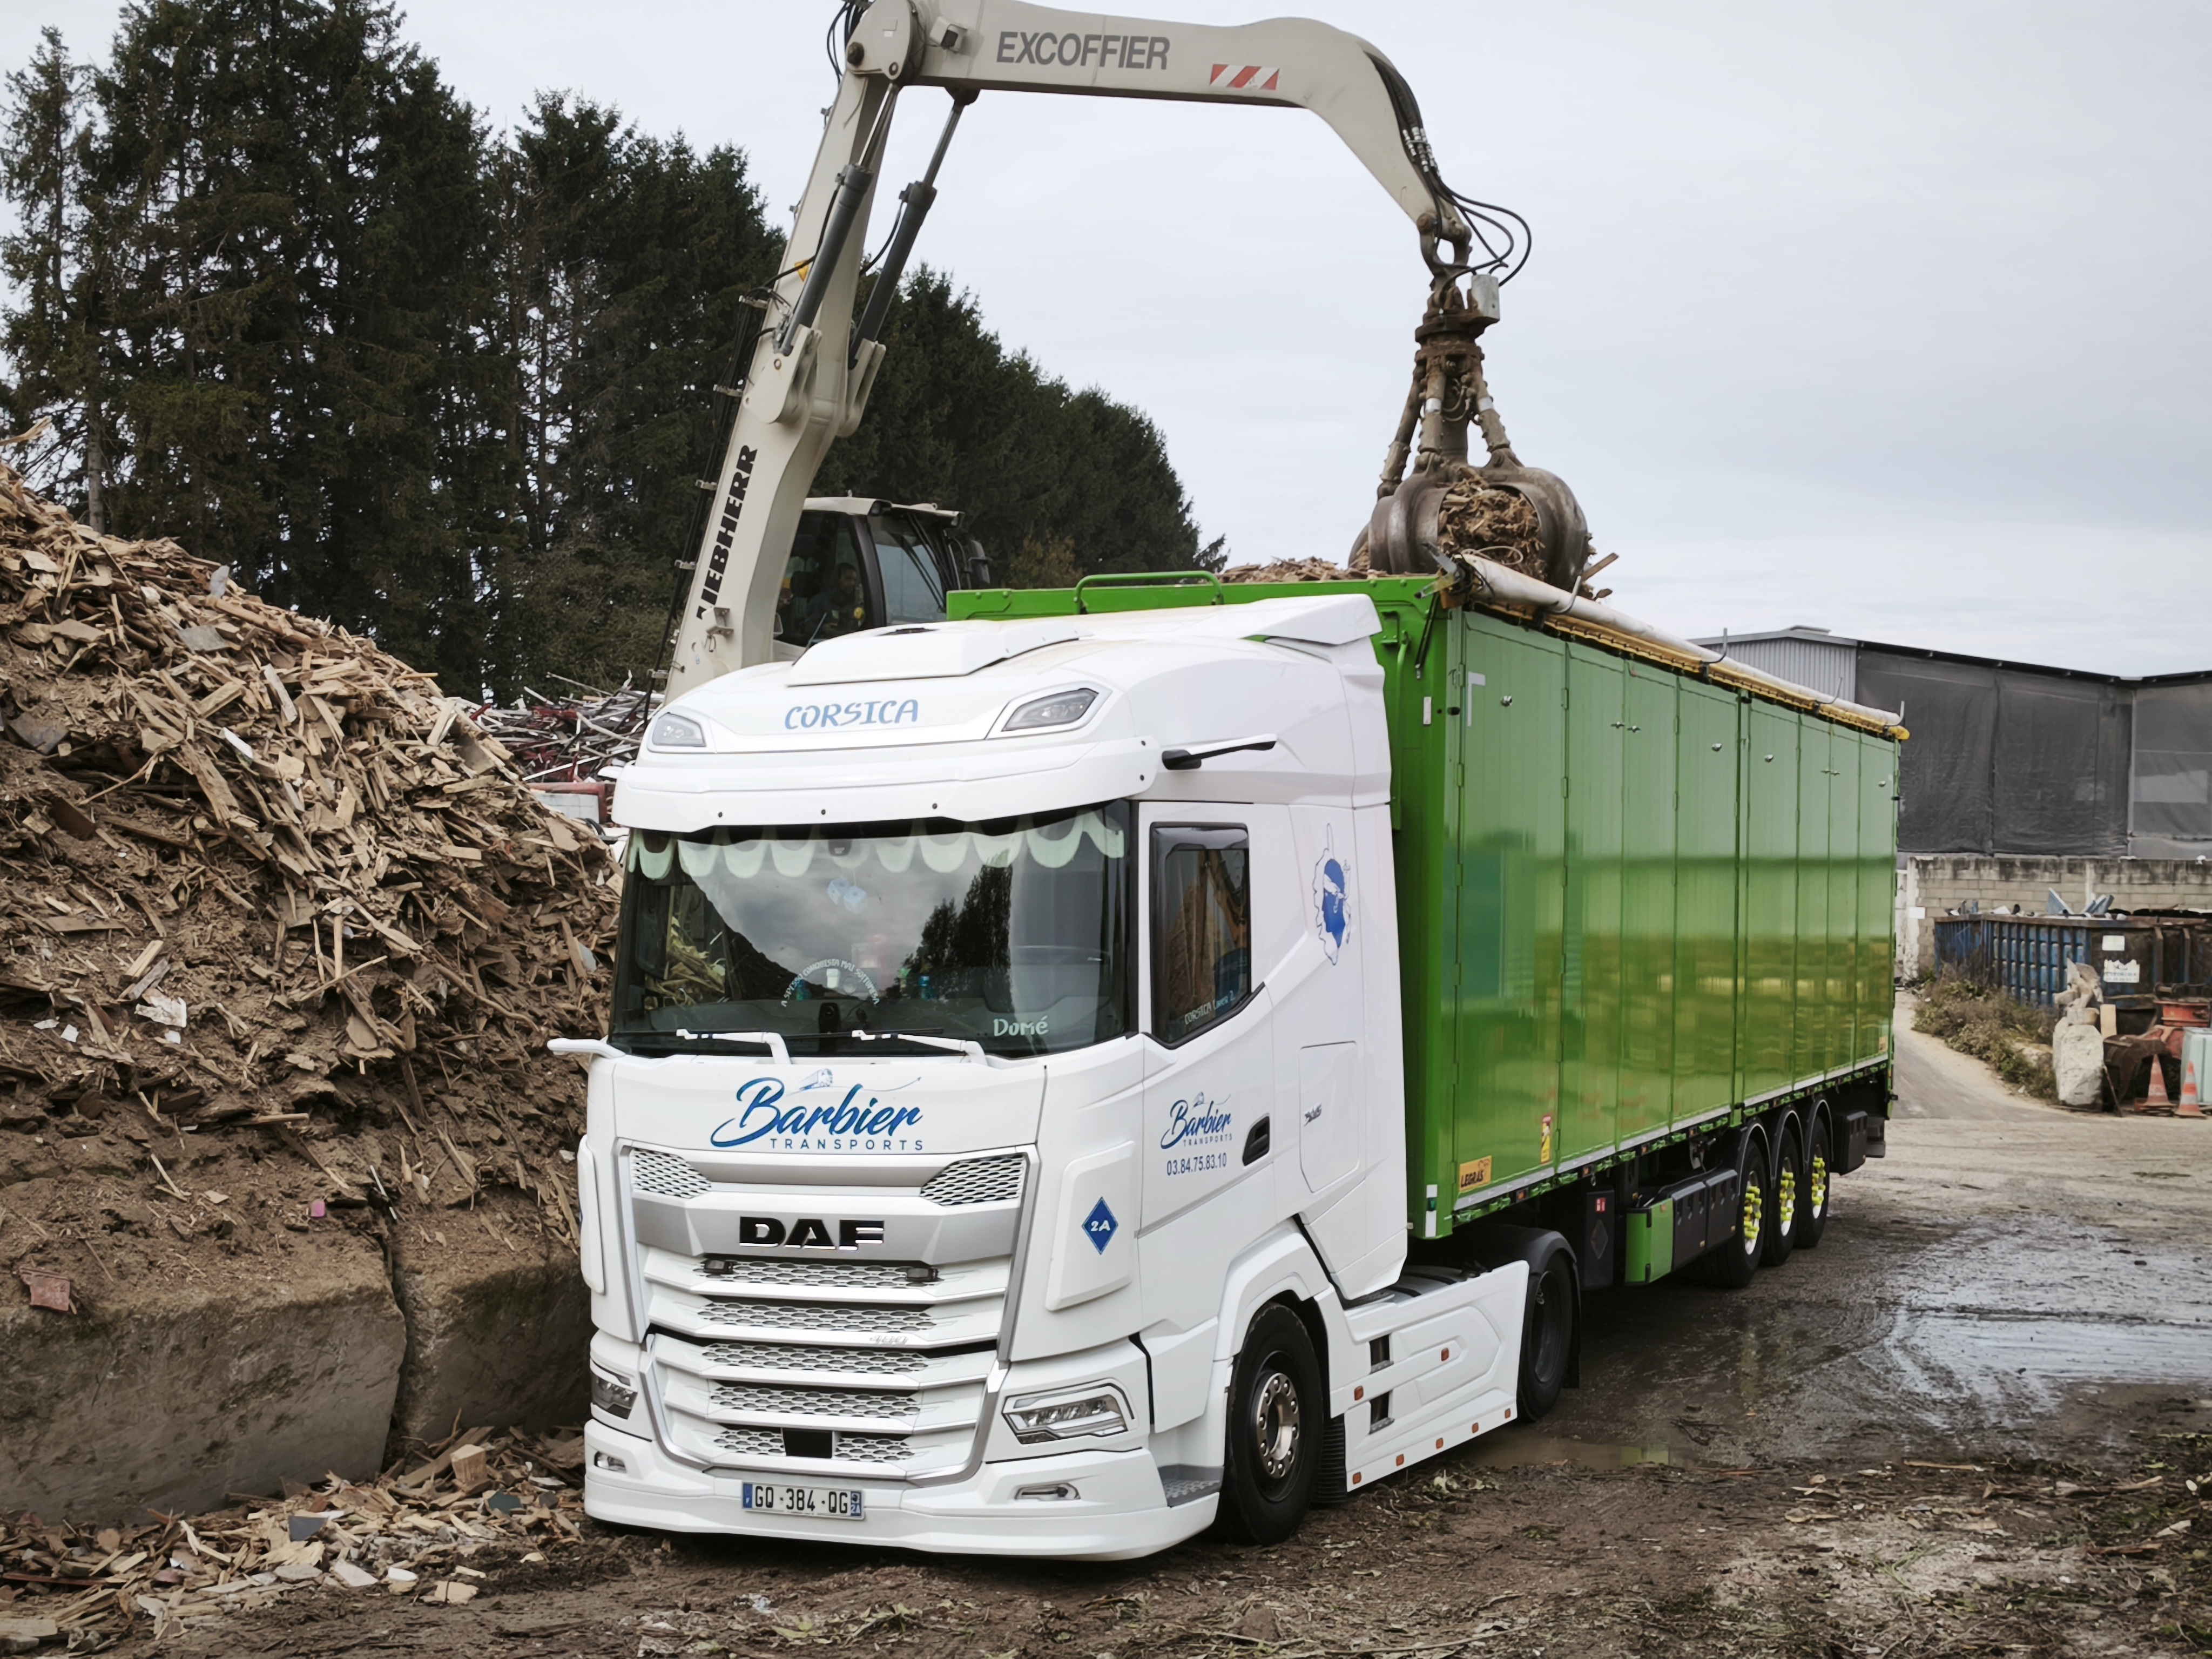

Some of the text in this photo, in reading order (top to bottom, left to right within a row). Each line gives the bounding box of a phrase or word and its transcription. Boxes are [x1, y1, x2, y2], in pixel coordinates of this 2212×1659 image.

[996, 31, 1170, 70] EXCOFFIER
[785, 699, 918, 730] CORSICA
[710, 1077, 924, 1148] Barbier
[1161, 1100, 1232, 1149] Barbier
[770, 1138, 923, 1150] TRANSPORTS
[1183, 1133, 1232, 1147] TRANSPORTS
[1166, 1152, 1227, 1176] 03.84.75.83.10
[1460, 1170, 1484, 1188] LEGRAS
[739, 1216, 885, 1251] DAF
[1090, 1219, 1111, 1232] 2A
